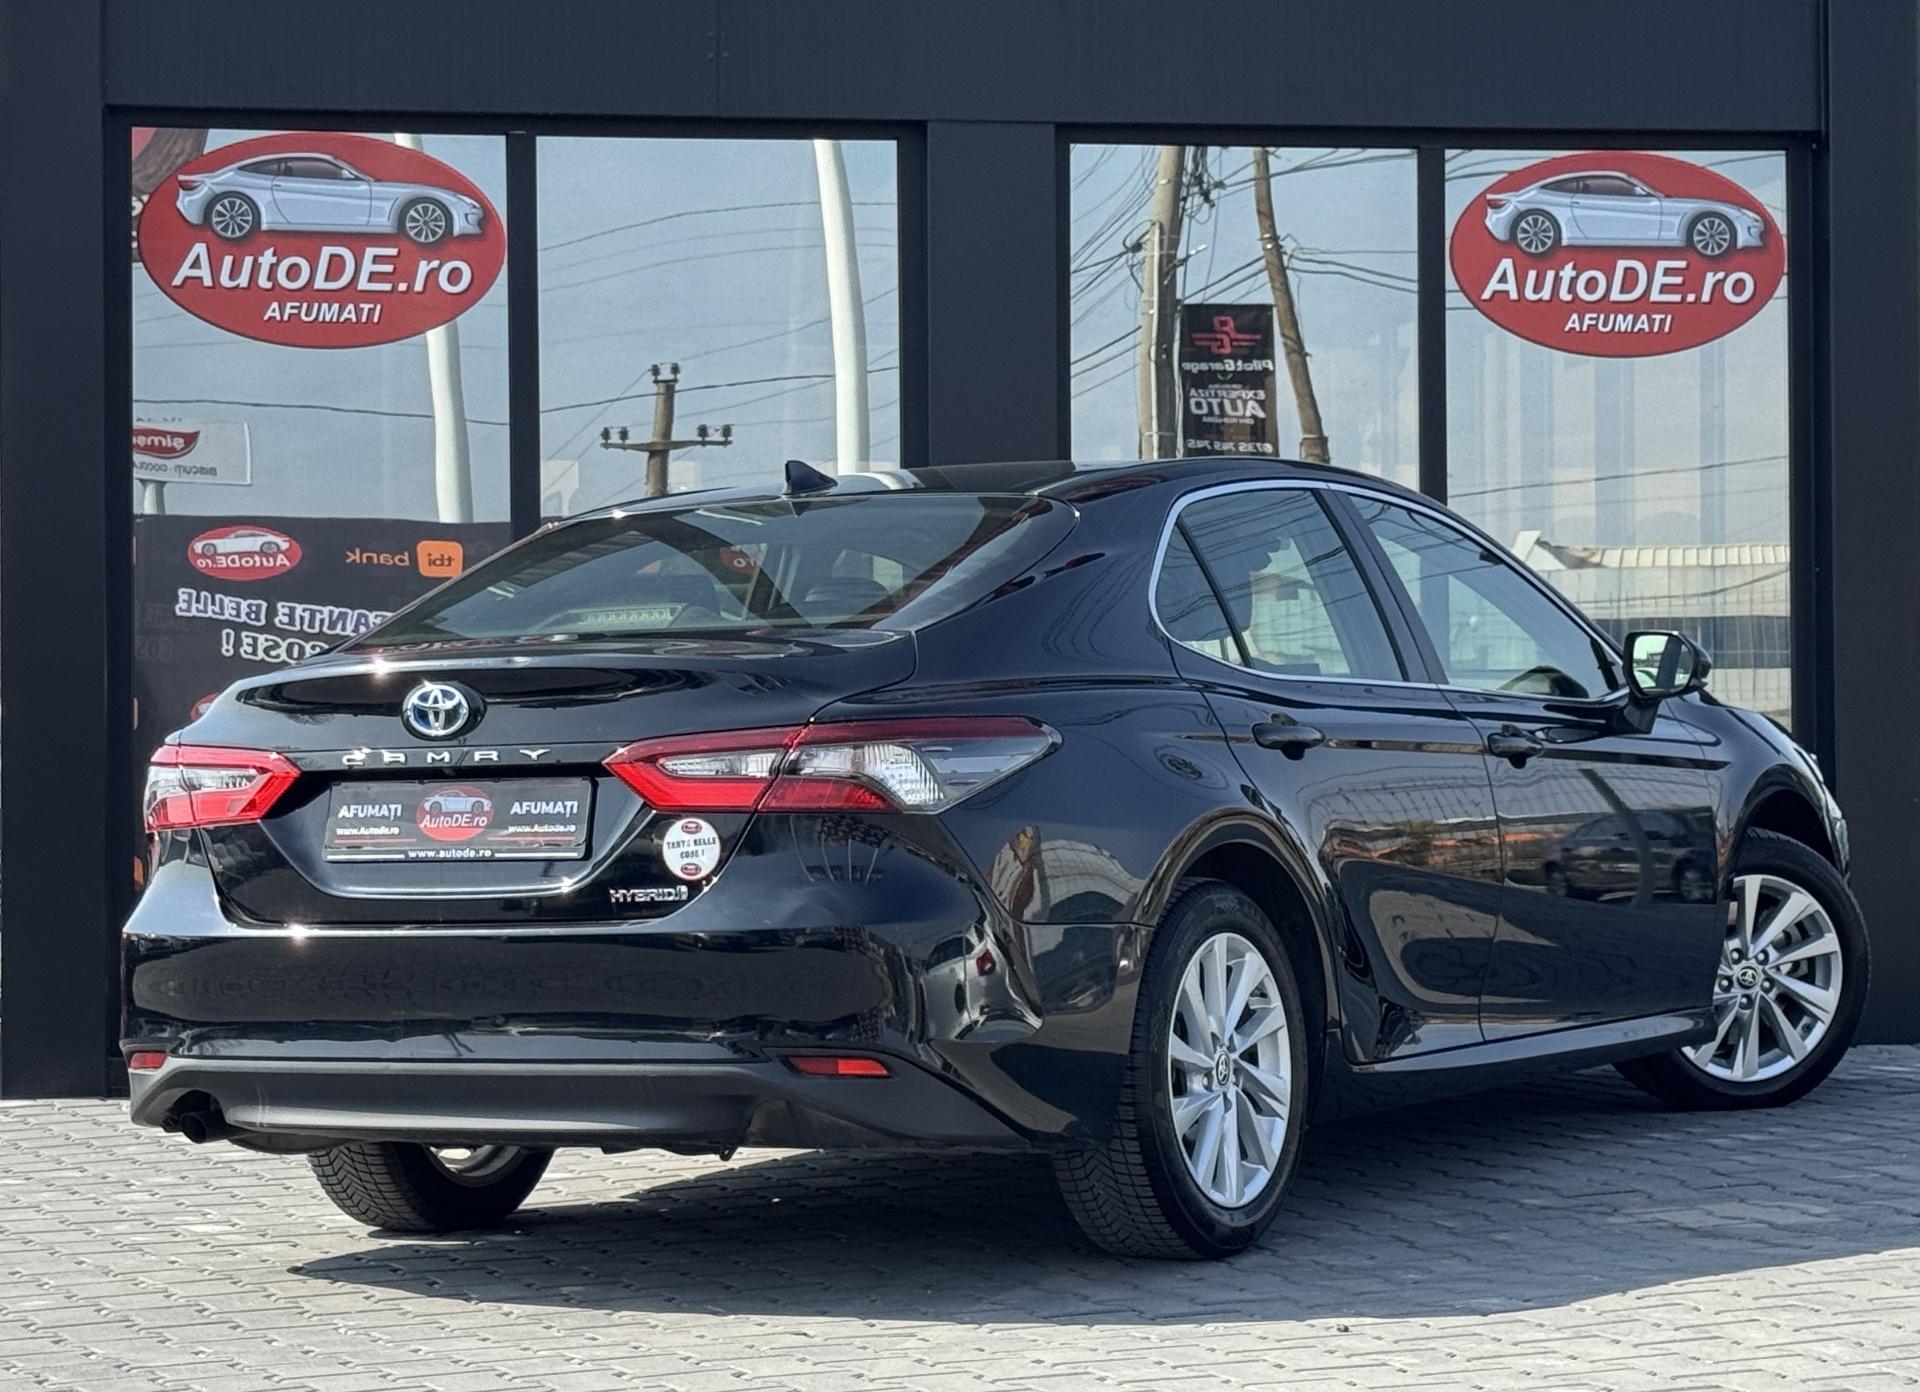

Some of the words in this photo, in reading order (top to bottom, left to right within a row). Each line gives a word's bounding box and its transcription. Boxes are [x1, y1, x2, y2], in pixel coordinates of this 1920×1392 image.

[172, 242, 473, 295] AutoDE.ro
[1481, 257, 1756, 304] AutoDE.ro
[263, 301, 382, 324] AFUMATI
[1564, 313, 1672, 334] AFUMATI
[342, 748, 550, 766] CAMRY
[419, 813, 488, 829] AutoDE.ro
[408, 848, 492, 858] www.autode.ro
[609, 887, 677, 903] HYBRID
